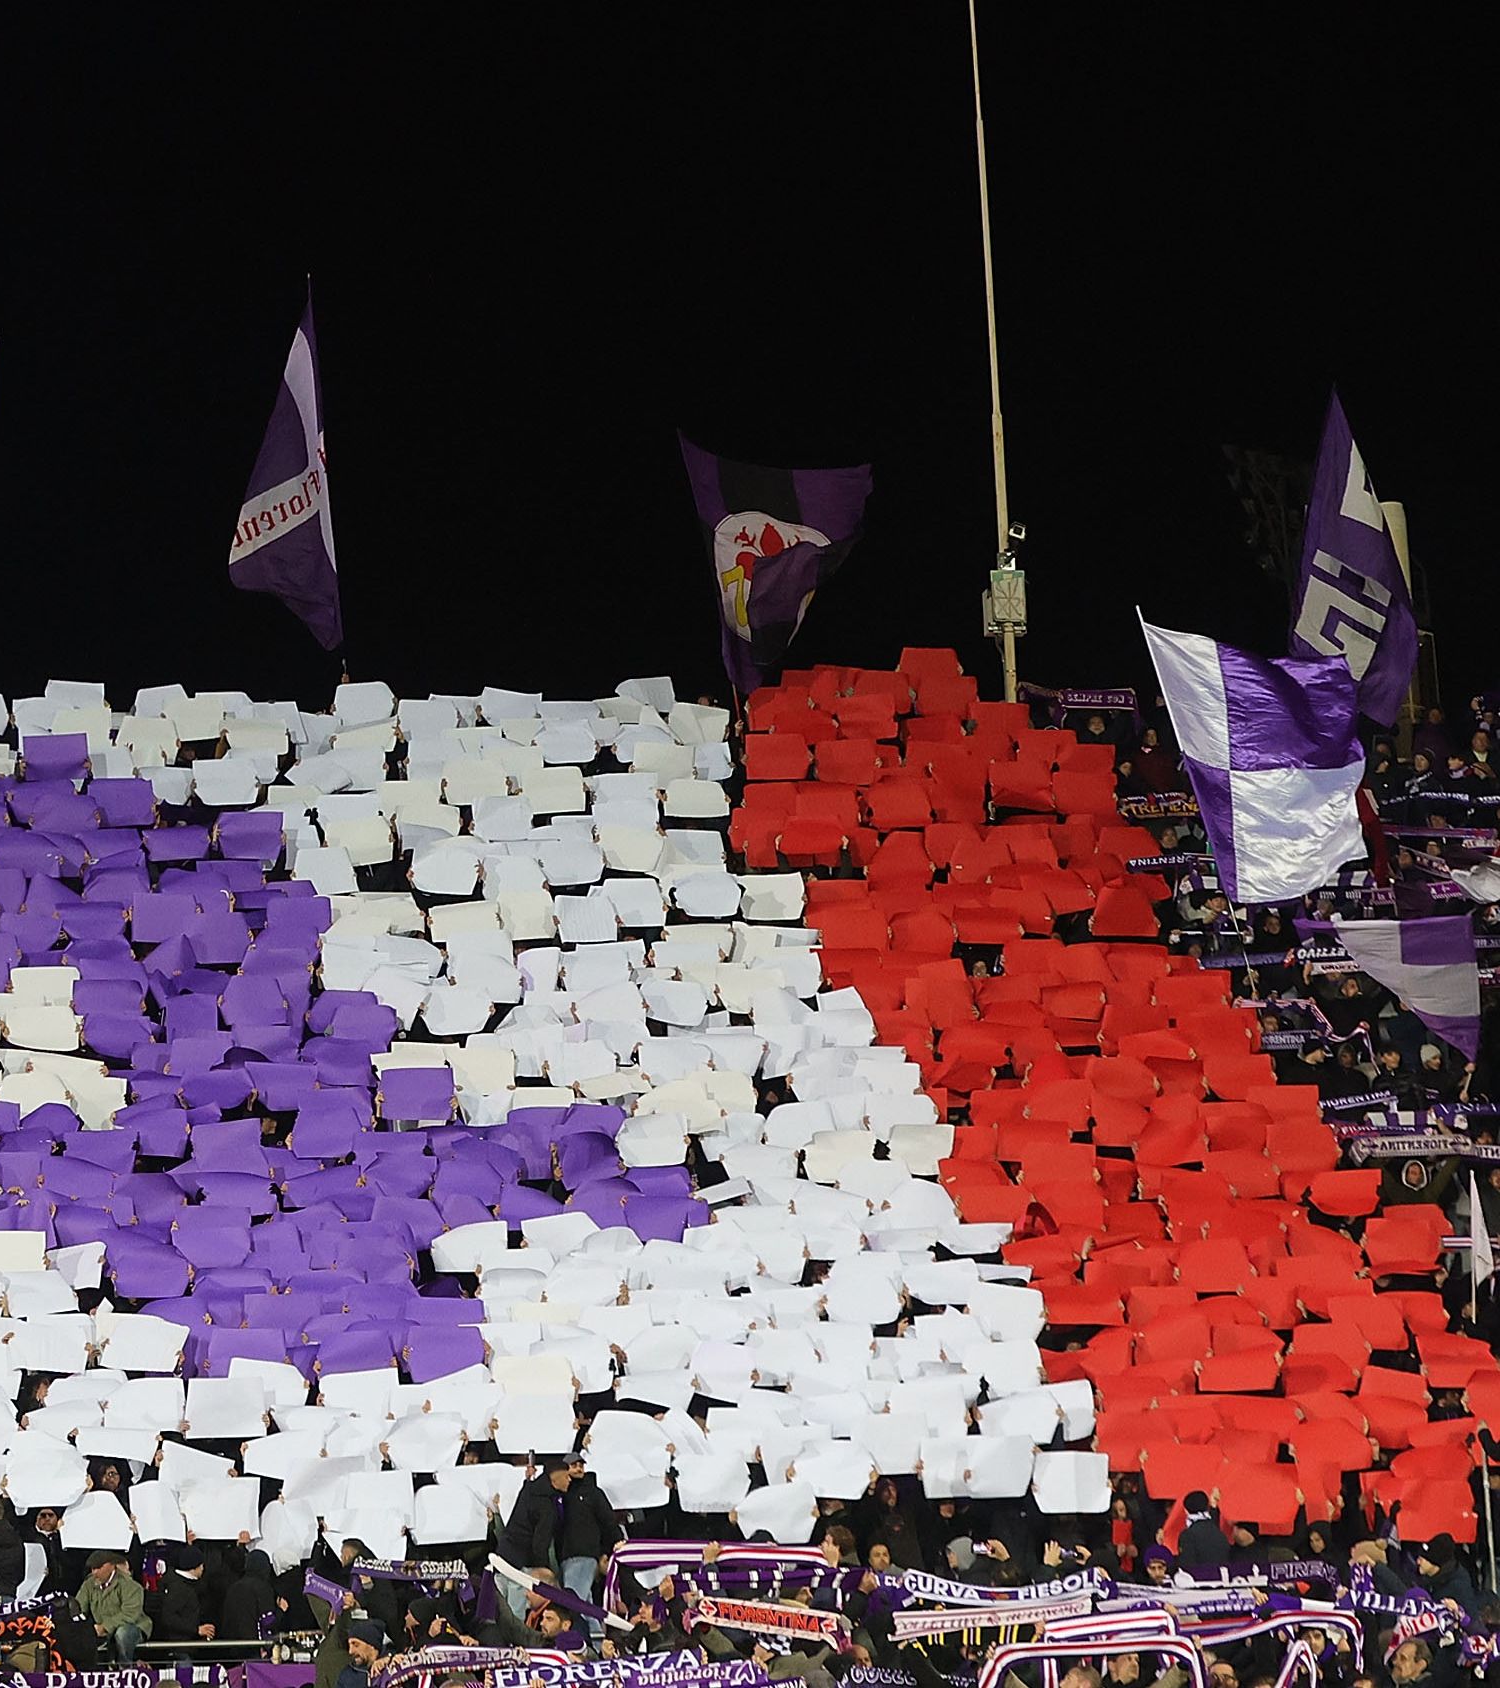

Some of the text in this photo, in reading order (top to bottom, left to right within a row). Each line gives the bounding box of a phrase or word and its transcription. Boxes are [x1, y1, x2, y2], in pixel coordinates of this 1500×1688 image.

[905, 1568, 1105, 1600] CURVA FIESOLE
[718, 1602, 821, 1631] FIORENTINA
[45, 1669, 151, 1688] D'URTO
[495, 1647, 702, 1688] FIORENZA
[637, 1666, 732, 1687] Fiorentina
